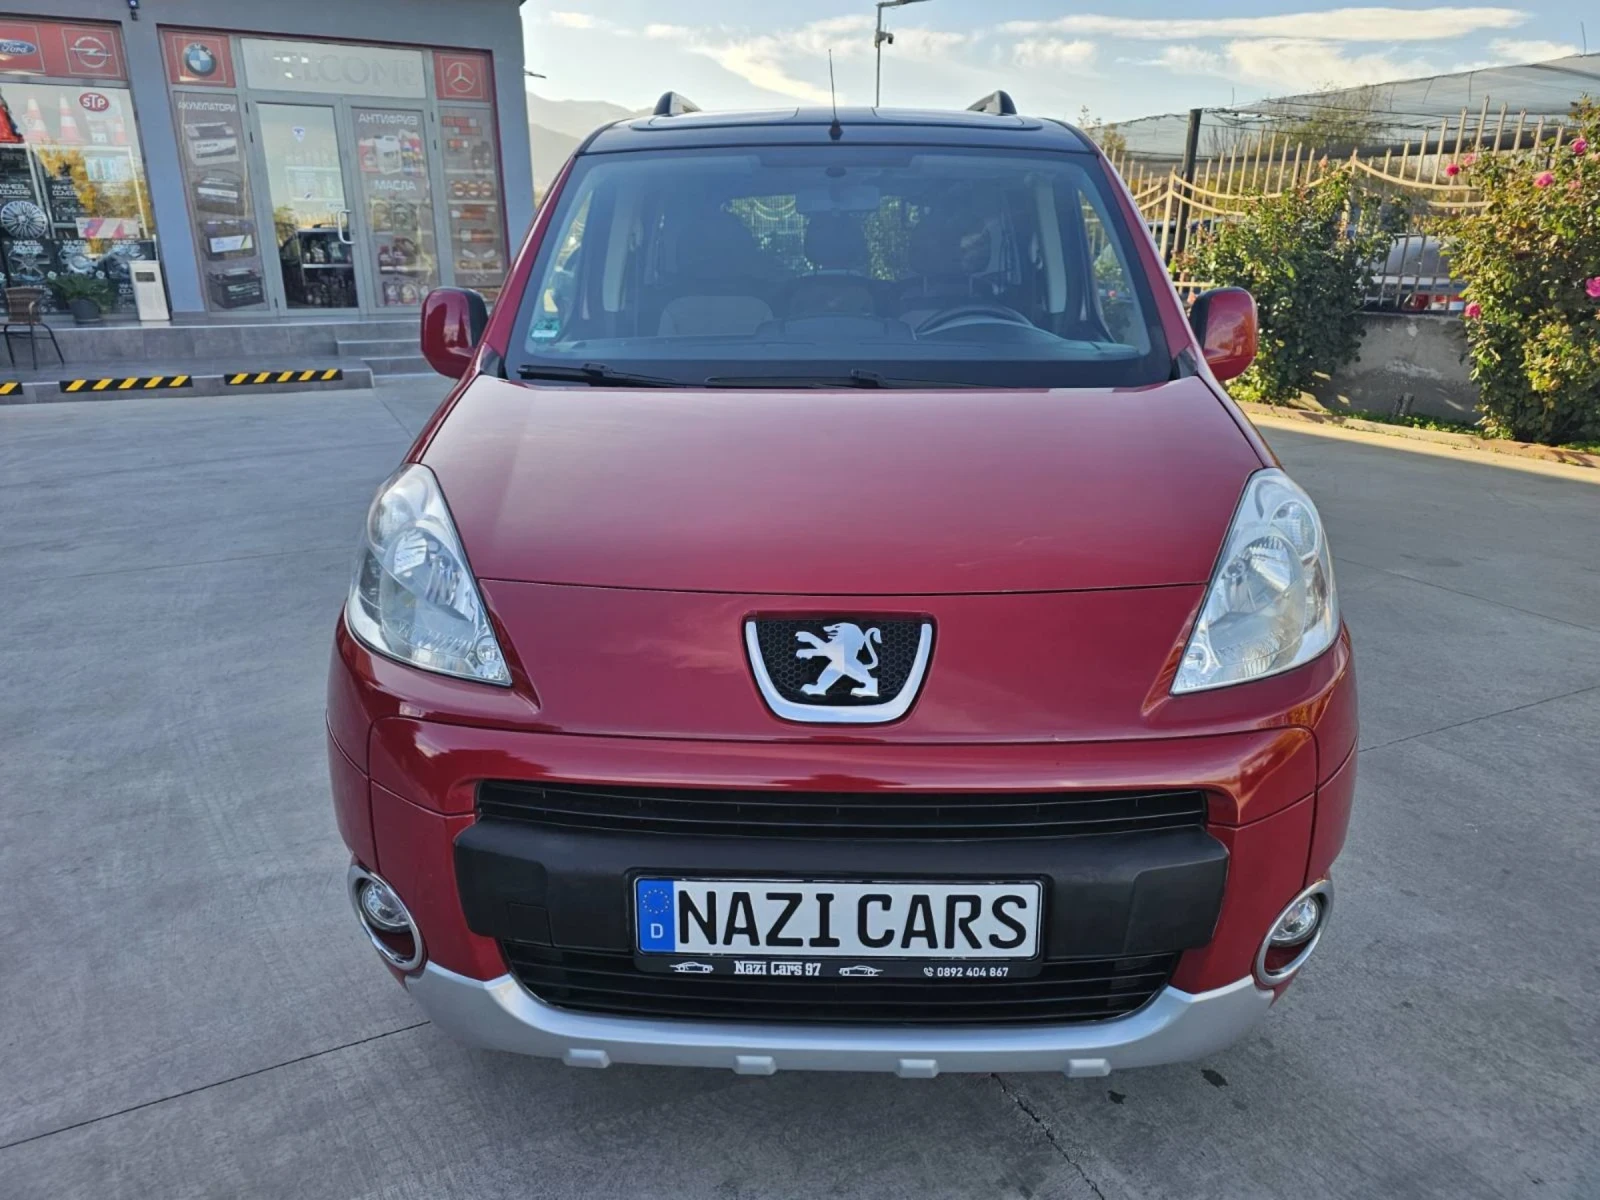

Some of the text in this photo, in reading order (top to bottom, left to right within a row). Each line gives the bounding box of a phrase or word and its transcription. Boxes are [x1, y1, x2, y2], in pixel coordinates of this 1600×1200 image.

[83, 94, 106, 108] STP
[374, 179, 417, 191] МАСЛА
[678, 890, 1027, 949] NAZI CARS
[650, 923, 664, 939] D
[734, 960, 821, 977] Nazi Cars 97
[937, 967, 1009, 977] 0892 404 867
